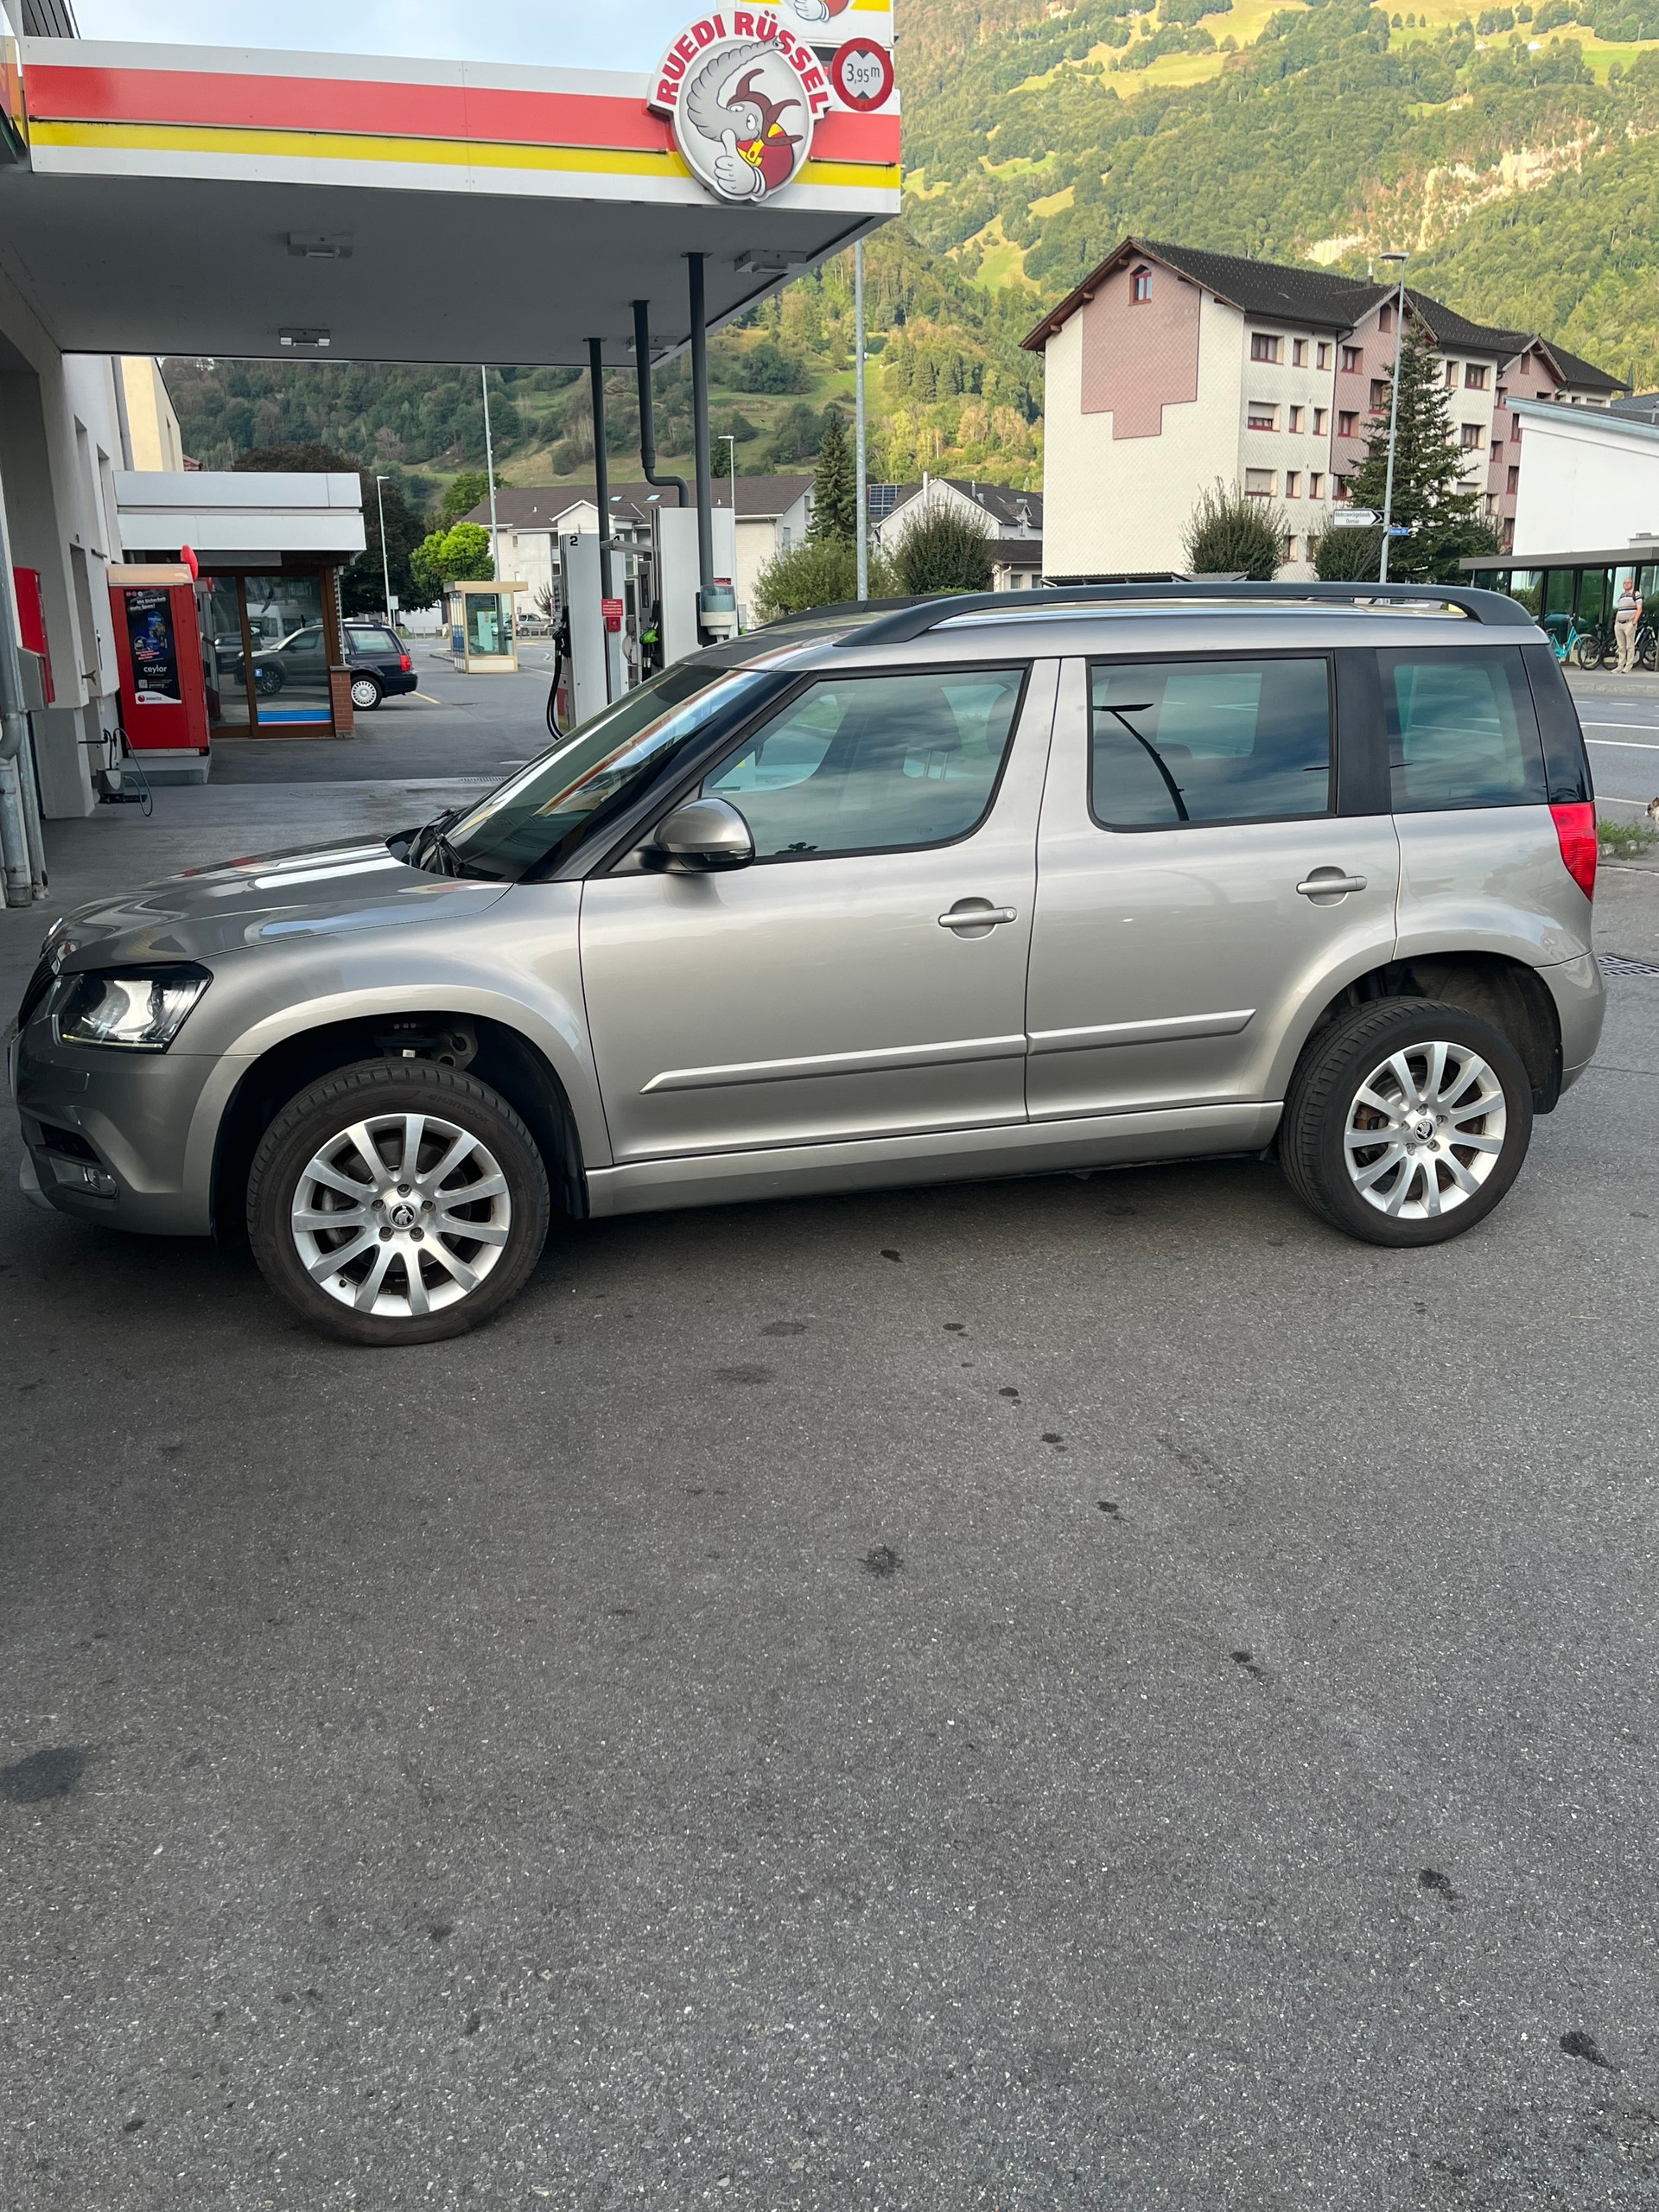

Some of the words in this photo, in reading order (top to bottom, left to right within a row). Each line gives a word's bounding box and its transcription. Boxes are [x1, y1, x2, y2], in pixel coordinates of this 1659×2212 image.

[656, 14, 726, 105] RUEDI
[734, 10, 830, 115] RÜSSEL
[569, 535, 579, 546] 2
[143, 664, 168, 674] ceylor
